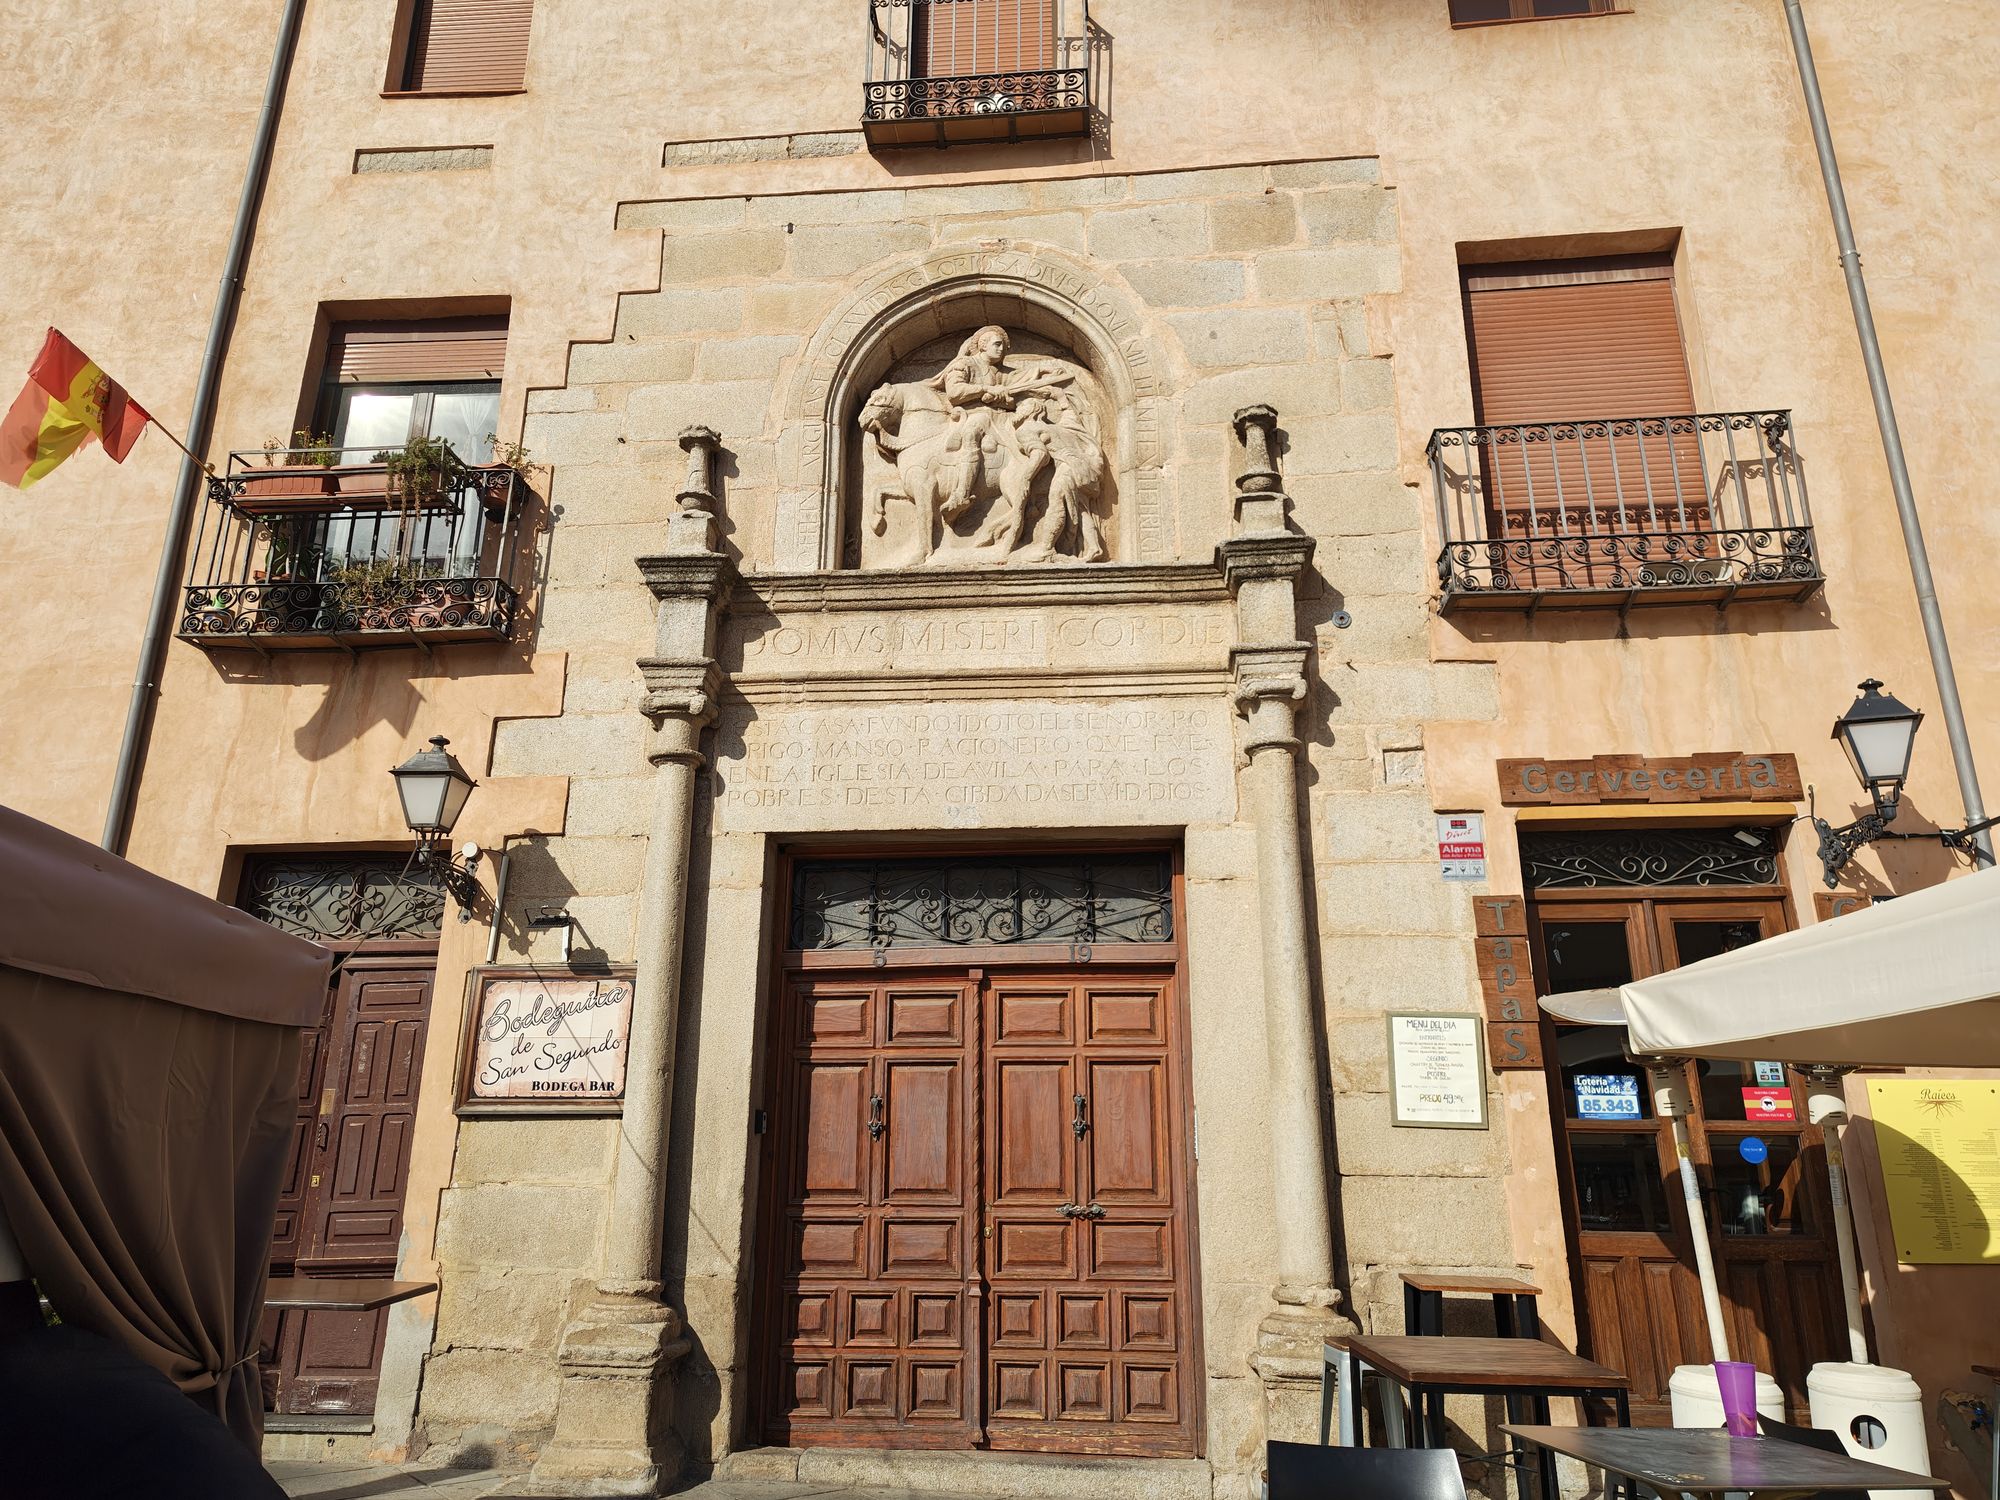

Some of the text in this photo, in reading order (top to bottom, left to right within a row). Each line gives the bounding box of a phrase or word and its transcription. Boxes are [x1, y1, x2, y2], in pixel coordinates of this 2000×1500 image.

[799, 717, 859, 735] CASA
[815, 739, 903, 758] MANSO
[1086, 734, 1140, 752] QVE
[812, 763, 912, 782] IGLESIA
[1144, 757, 1202, 776] LOS
[846, 786, 930, 805] DESTA
[1442, 844, 1481, 854] Alarma
[872, 948, 887, 968] 5
[1068, 943, 1093, 963] 19
[482, 986, 628, 1042] Bodeguita
[1430, 1020, 1442, 1029] DEL
[510, 1032, 535, 1056] de
[480, 1029, 622, 1086] San Segundo
[531, 1080, 615, 1091] BODEGA BAR
[1576, 1077, 1608, 1086] Lotería
[1584, 1085, 1621, 1094] Navidad
[1583, 1099, 1635, 1112] 85.343
